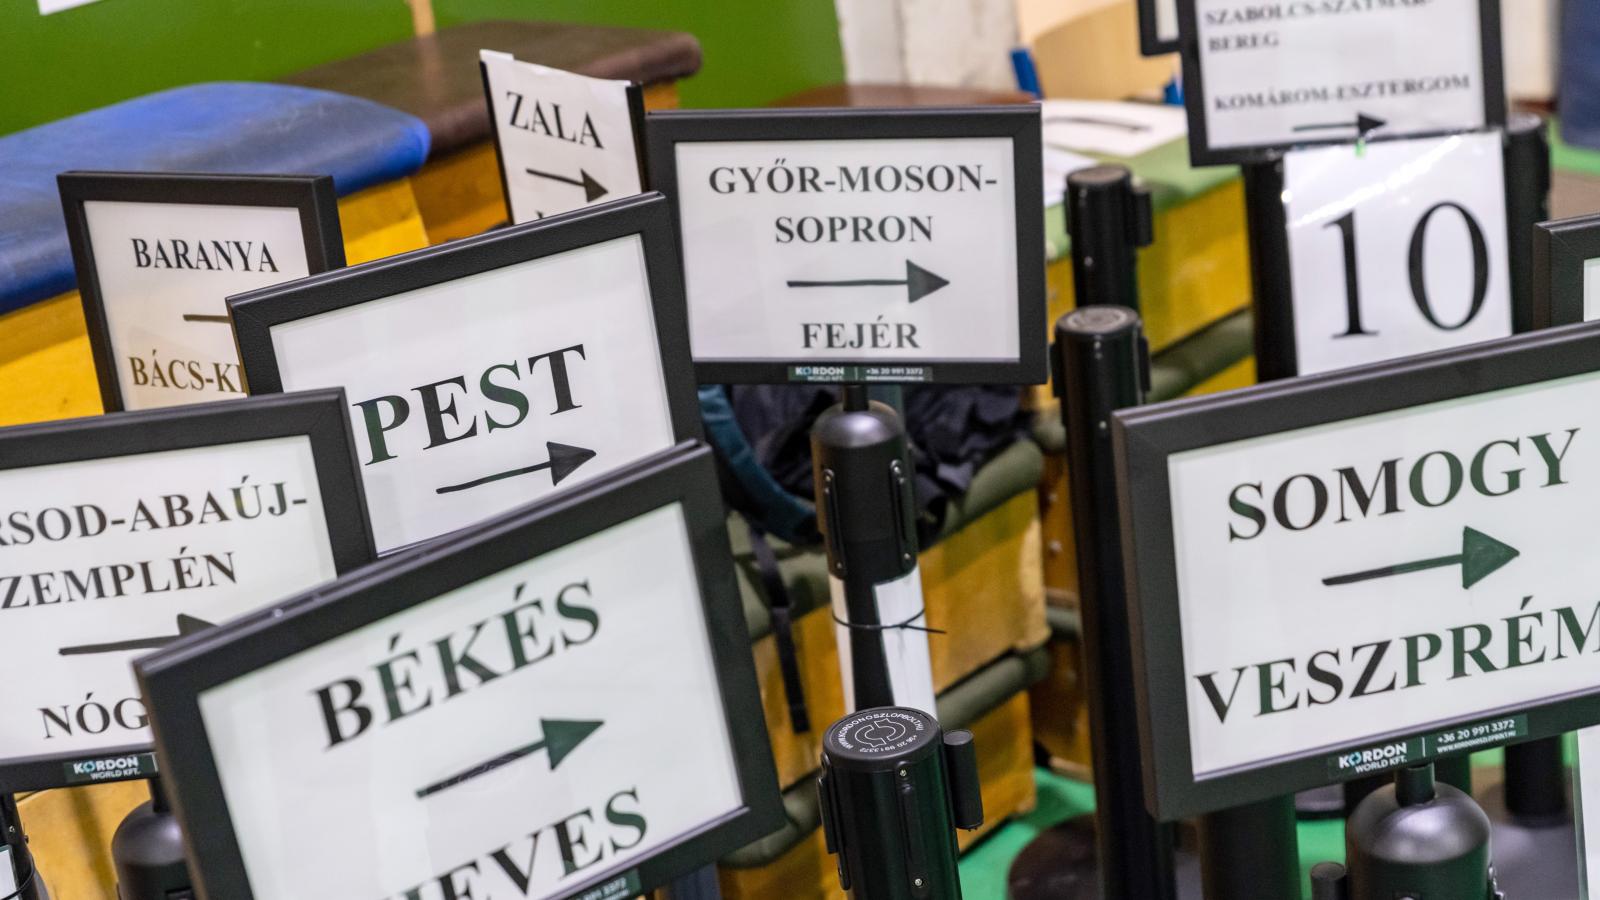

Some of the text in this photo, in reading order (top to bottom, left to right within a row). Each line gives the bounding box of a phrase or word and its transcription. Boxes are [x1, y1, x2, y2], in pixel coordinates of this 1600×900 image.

[1208, 32, 1279, 51] BEREG
[1214, 75, 1471, 111] KOMÁROM-ESZTERGOM
[506, 91, 604, 150] ZALA
[708, 158, 998, 194] GYŐR-MOSON-
[774, 215, 933, 243] SOPRON
[130, 238, 280, 273] BARANYA
[1321, 201, 1490, 340] 10
[800, 315, 921, 349] FEJÉR
[352, 343, 586, 466] PEST
[1228, 428, 1581, 542] SOMOGY
[0, 475, 308, 546] SOD-ABAÚJ-
[0, 546, 237, 609] ZEMPLÉN
[310, 579, 600, 751] BÉKÉS
[1193, 595, 1600, 724] VESZPRÉM
[37, 692, 150, 739] NÓG
[1437, 719, 1515, 743] +36 20 991 3372
[73, 756, 139, 774] KORDON
[1338, 742, 1408, 769] KORDON
[1355, 759, 1389, 774] WORLD
[381, 786, 647, 900] EVES
